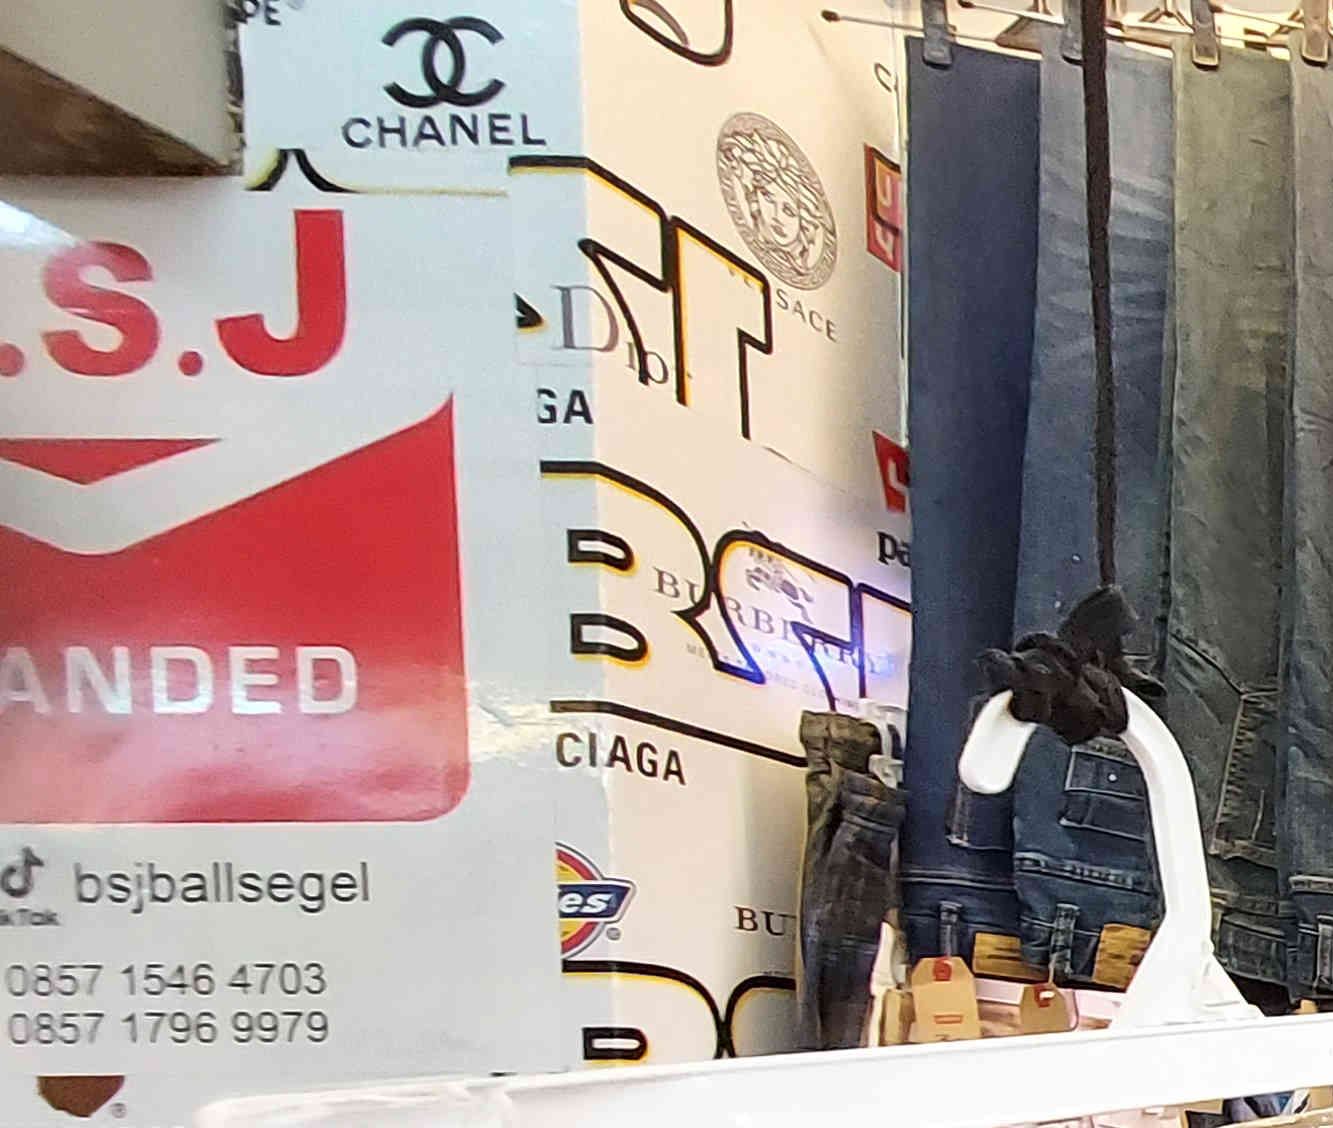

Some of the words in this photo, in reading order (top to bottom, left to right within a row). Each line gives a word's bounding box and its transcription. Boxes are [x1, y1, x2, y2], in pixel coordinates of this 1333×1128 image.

[341, 113, 547, 149] CHANEL
[0, 645, 358, 715] ANDED
[74, 863, 369, 914] bsjballsegel
[7, 963, 103, 996] 0857
[120, 963, 216, 996] 1546
[228, 962, 327, 995] 4703
[8, 1012, 105, 1044] 0857
[121, 1011, 218, 1043] 1796
[231, 1010, 329, 1043] 9979
